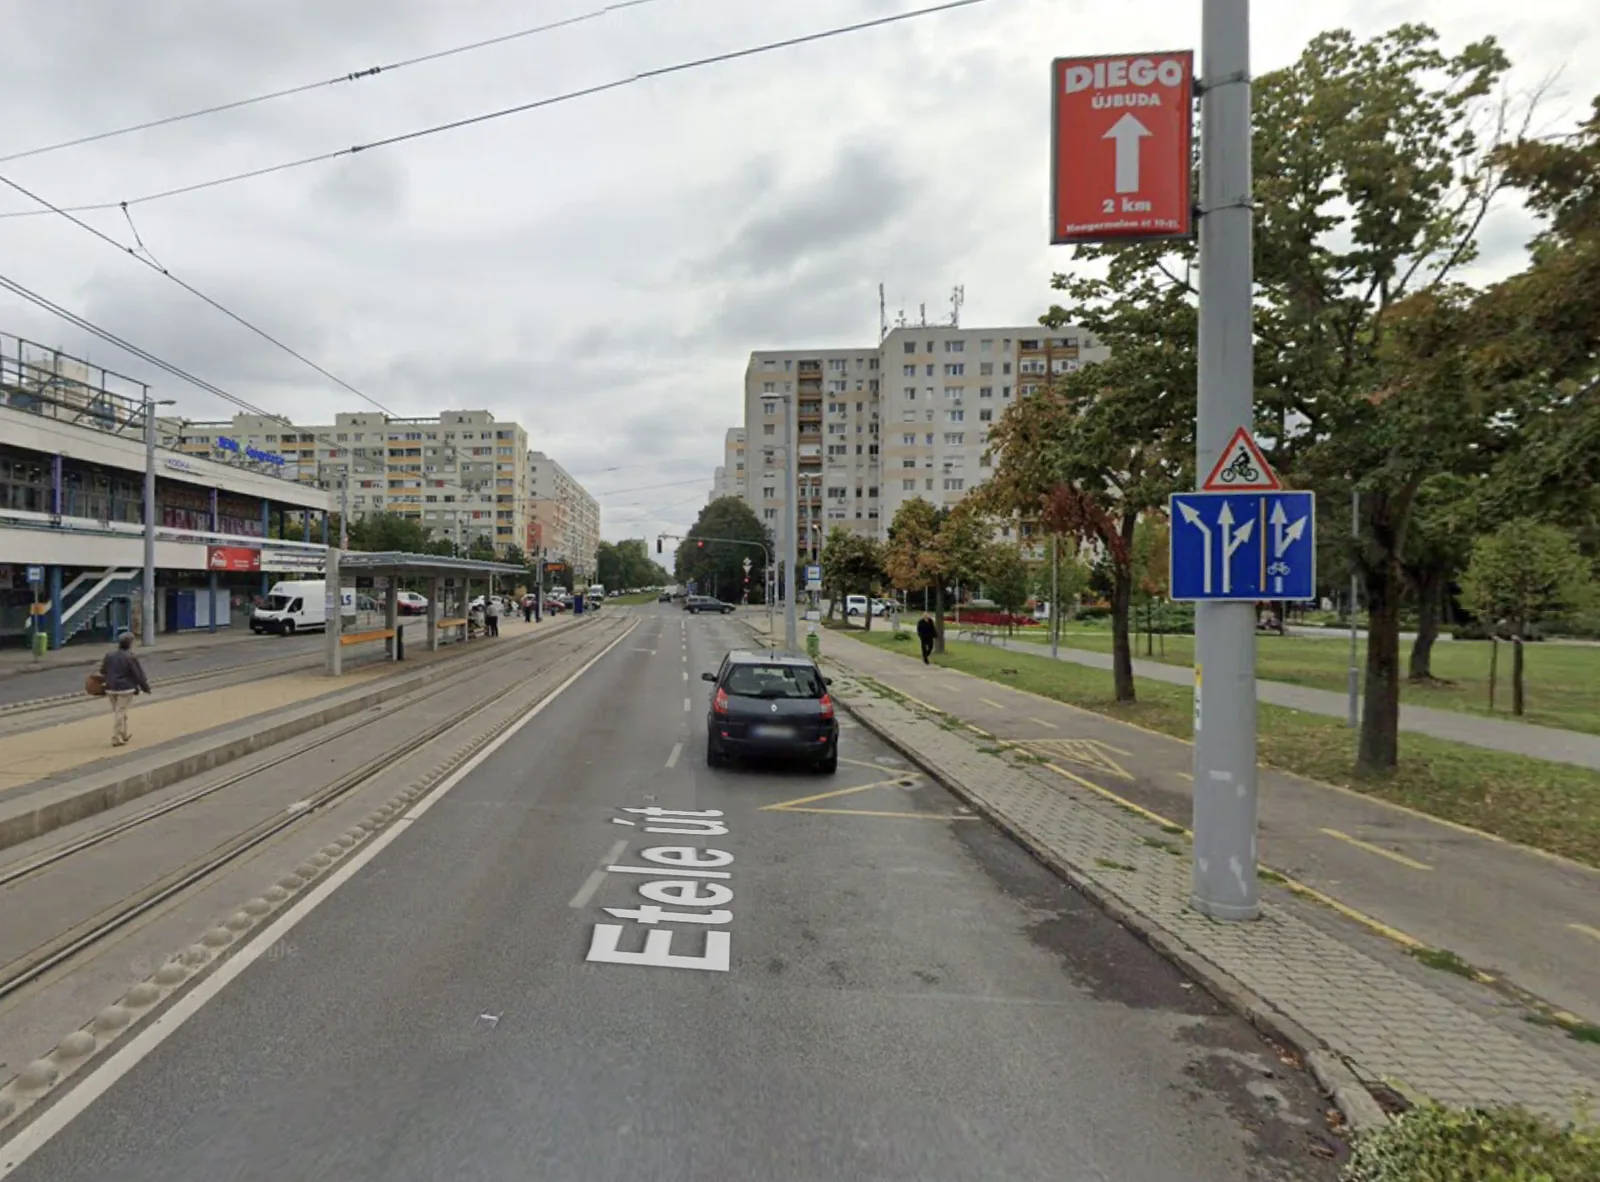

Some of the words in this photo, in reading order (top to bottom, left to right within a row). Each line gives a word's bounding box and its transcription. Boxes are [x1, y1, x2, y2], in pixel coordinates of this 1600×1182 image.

[1065, 58, 1183, 94] DIEGO
[1092, 92, 1161, 109] ÚJBUDA
[1102, 198, 1115, 213] 2
[1121, 197, 1151, 212] km
[340, 593, 352, 606] LS
